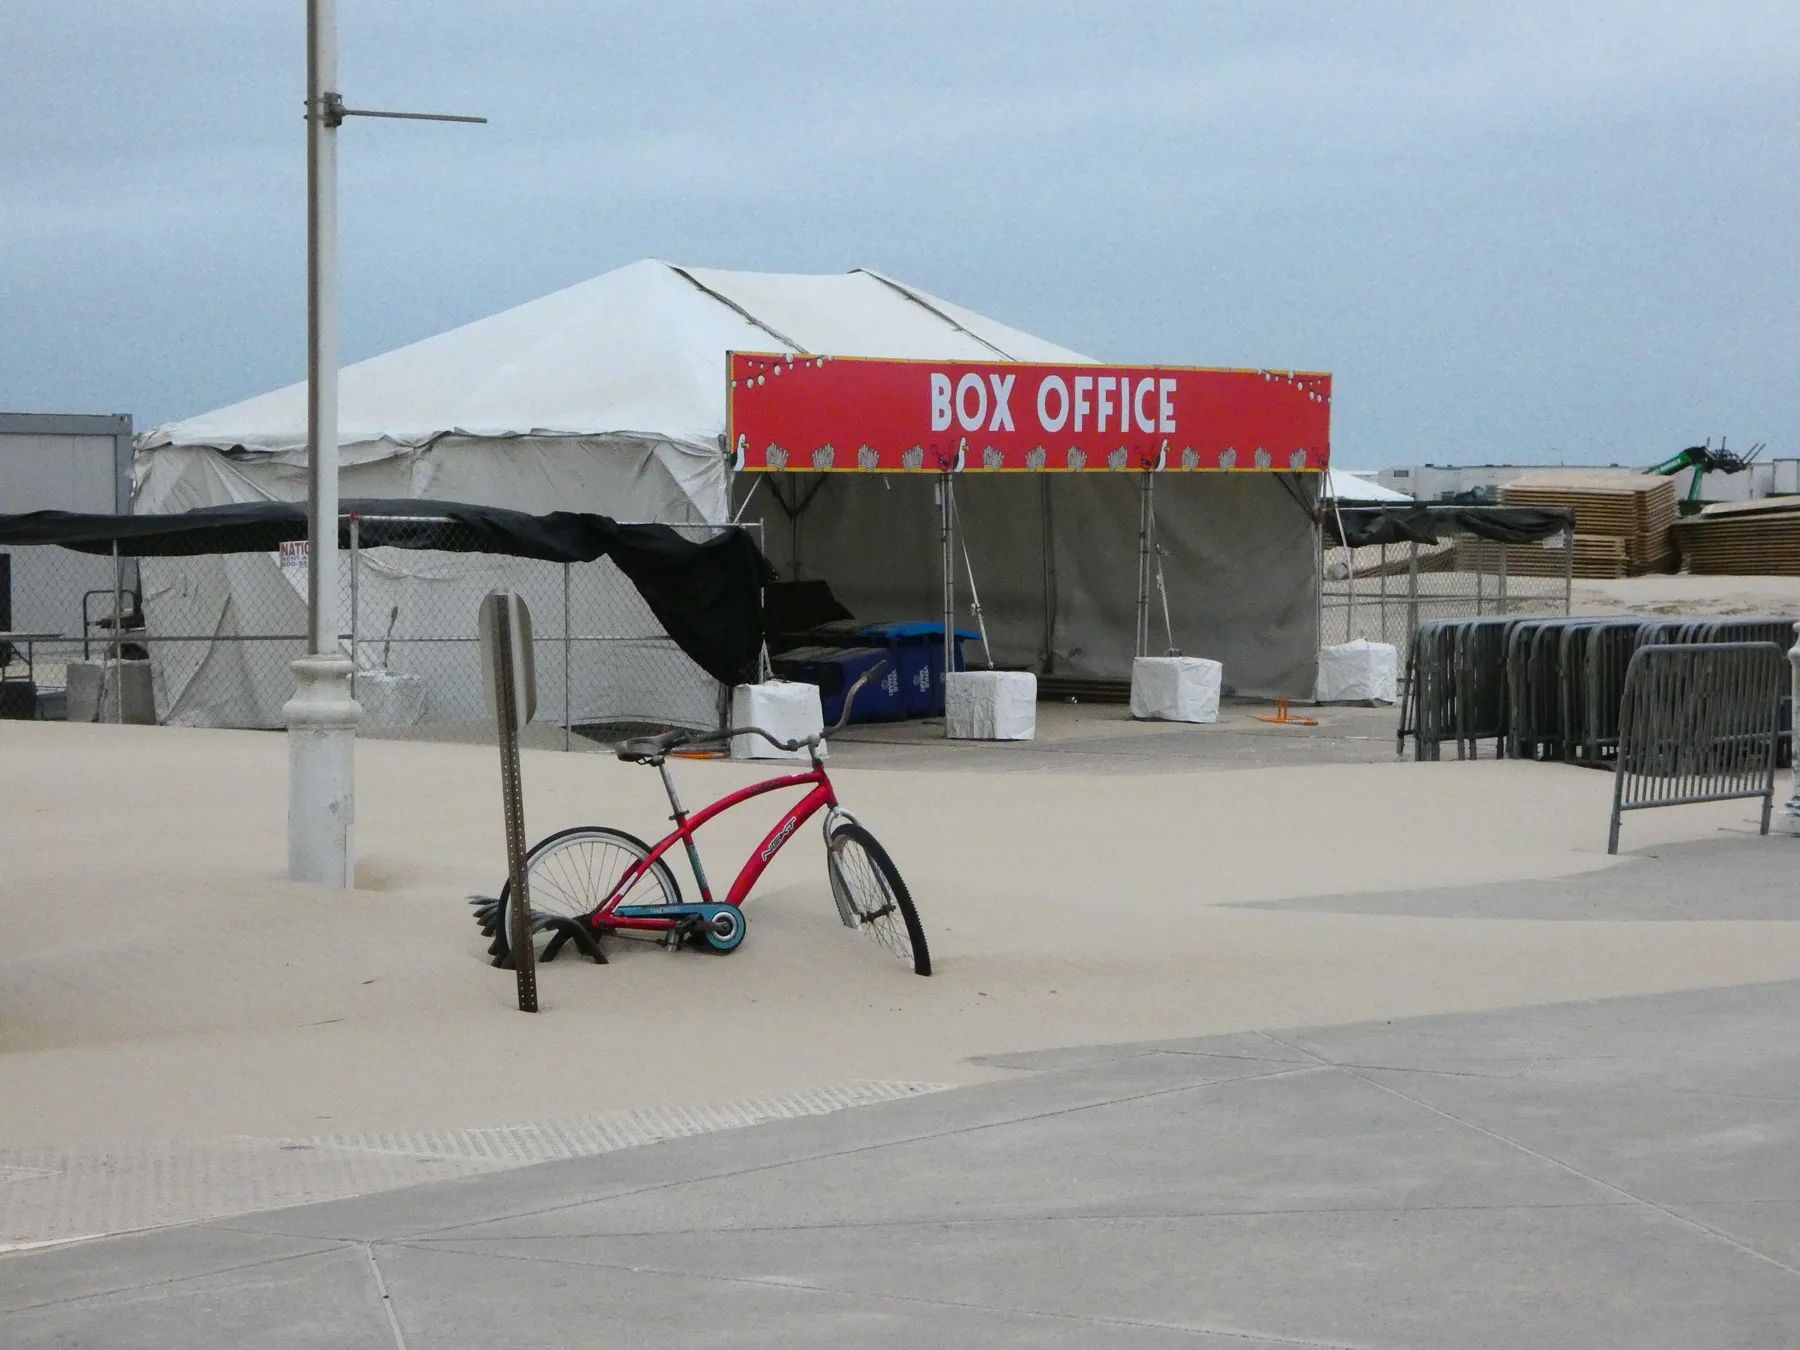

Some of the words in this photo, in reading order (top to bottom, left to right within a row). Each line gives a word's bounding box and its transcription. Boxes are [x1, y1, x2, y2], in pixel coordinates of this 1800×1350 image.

[930, 372, 1016, 432] BOX
[1037, 374, 1177, 434] OFFICE
[761, 816, 796, 861] NEXT
